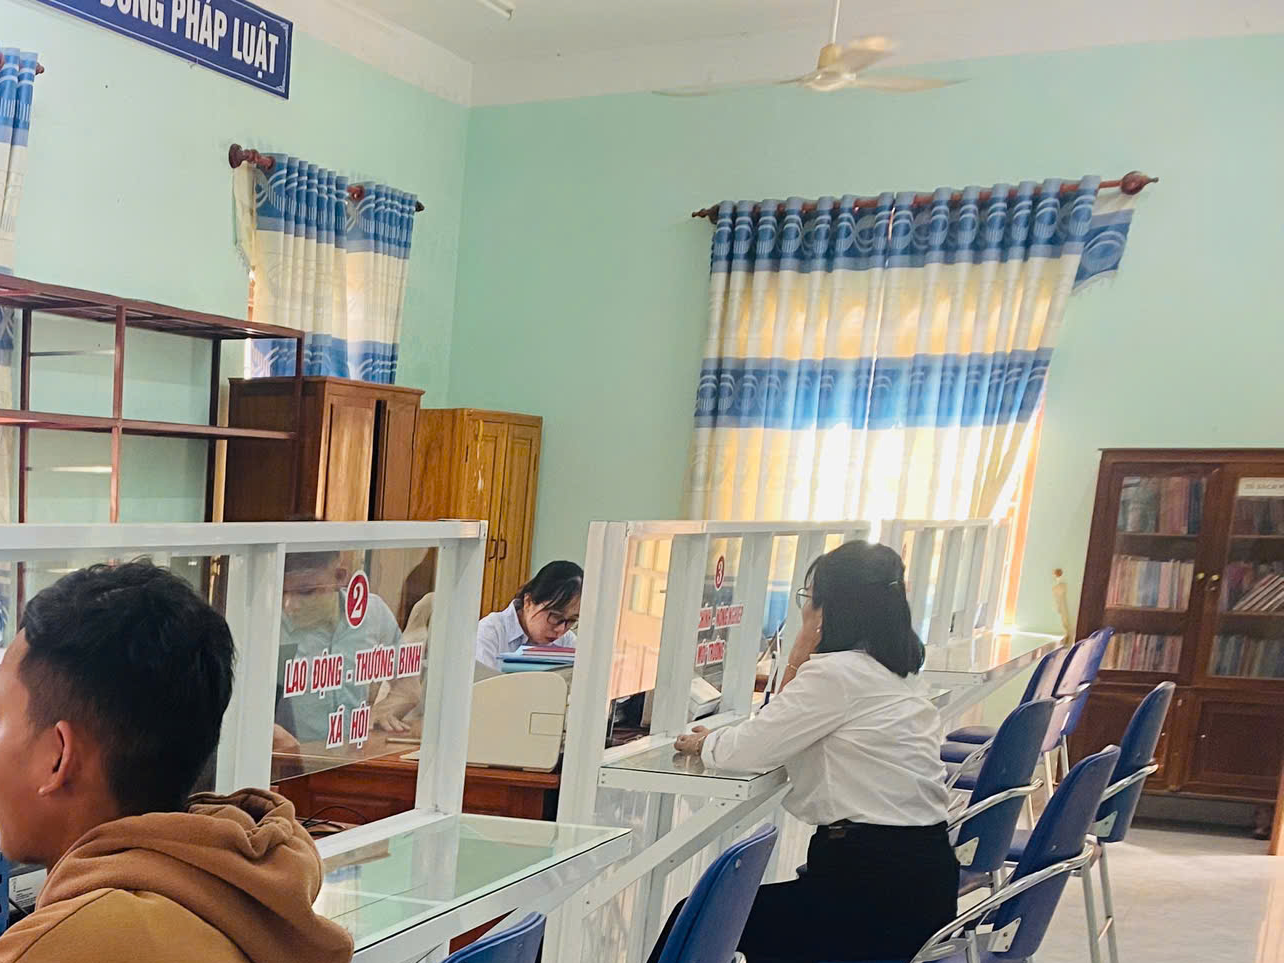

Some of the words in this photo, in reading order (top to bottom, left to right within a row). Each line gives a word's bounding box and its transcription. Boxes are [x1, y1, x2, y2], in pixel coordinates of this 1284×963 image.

[100, 0, 164, 29] NG
[170, 0, 228, 51] PHÁP
[232, 17, 279, 79] LUẬT
[350, 582, 364, 619] 2
[284, 658, 307, 695] LAO
[312, 649, 343, 699] ĐỘNG
[355, 646, 395, 683] THƯƠNG
[398, 644, 423, 675] BINH
[350, 702, 370, 748] HỘI
